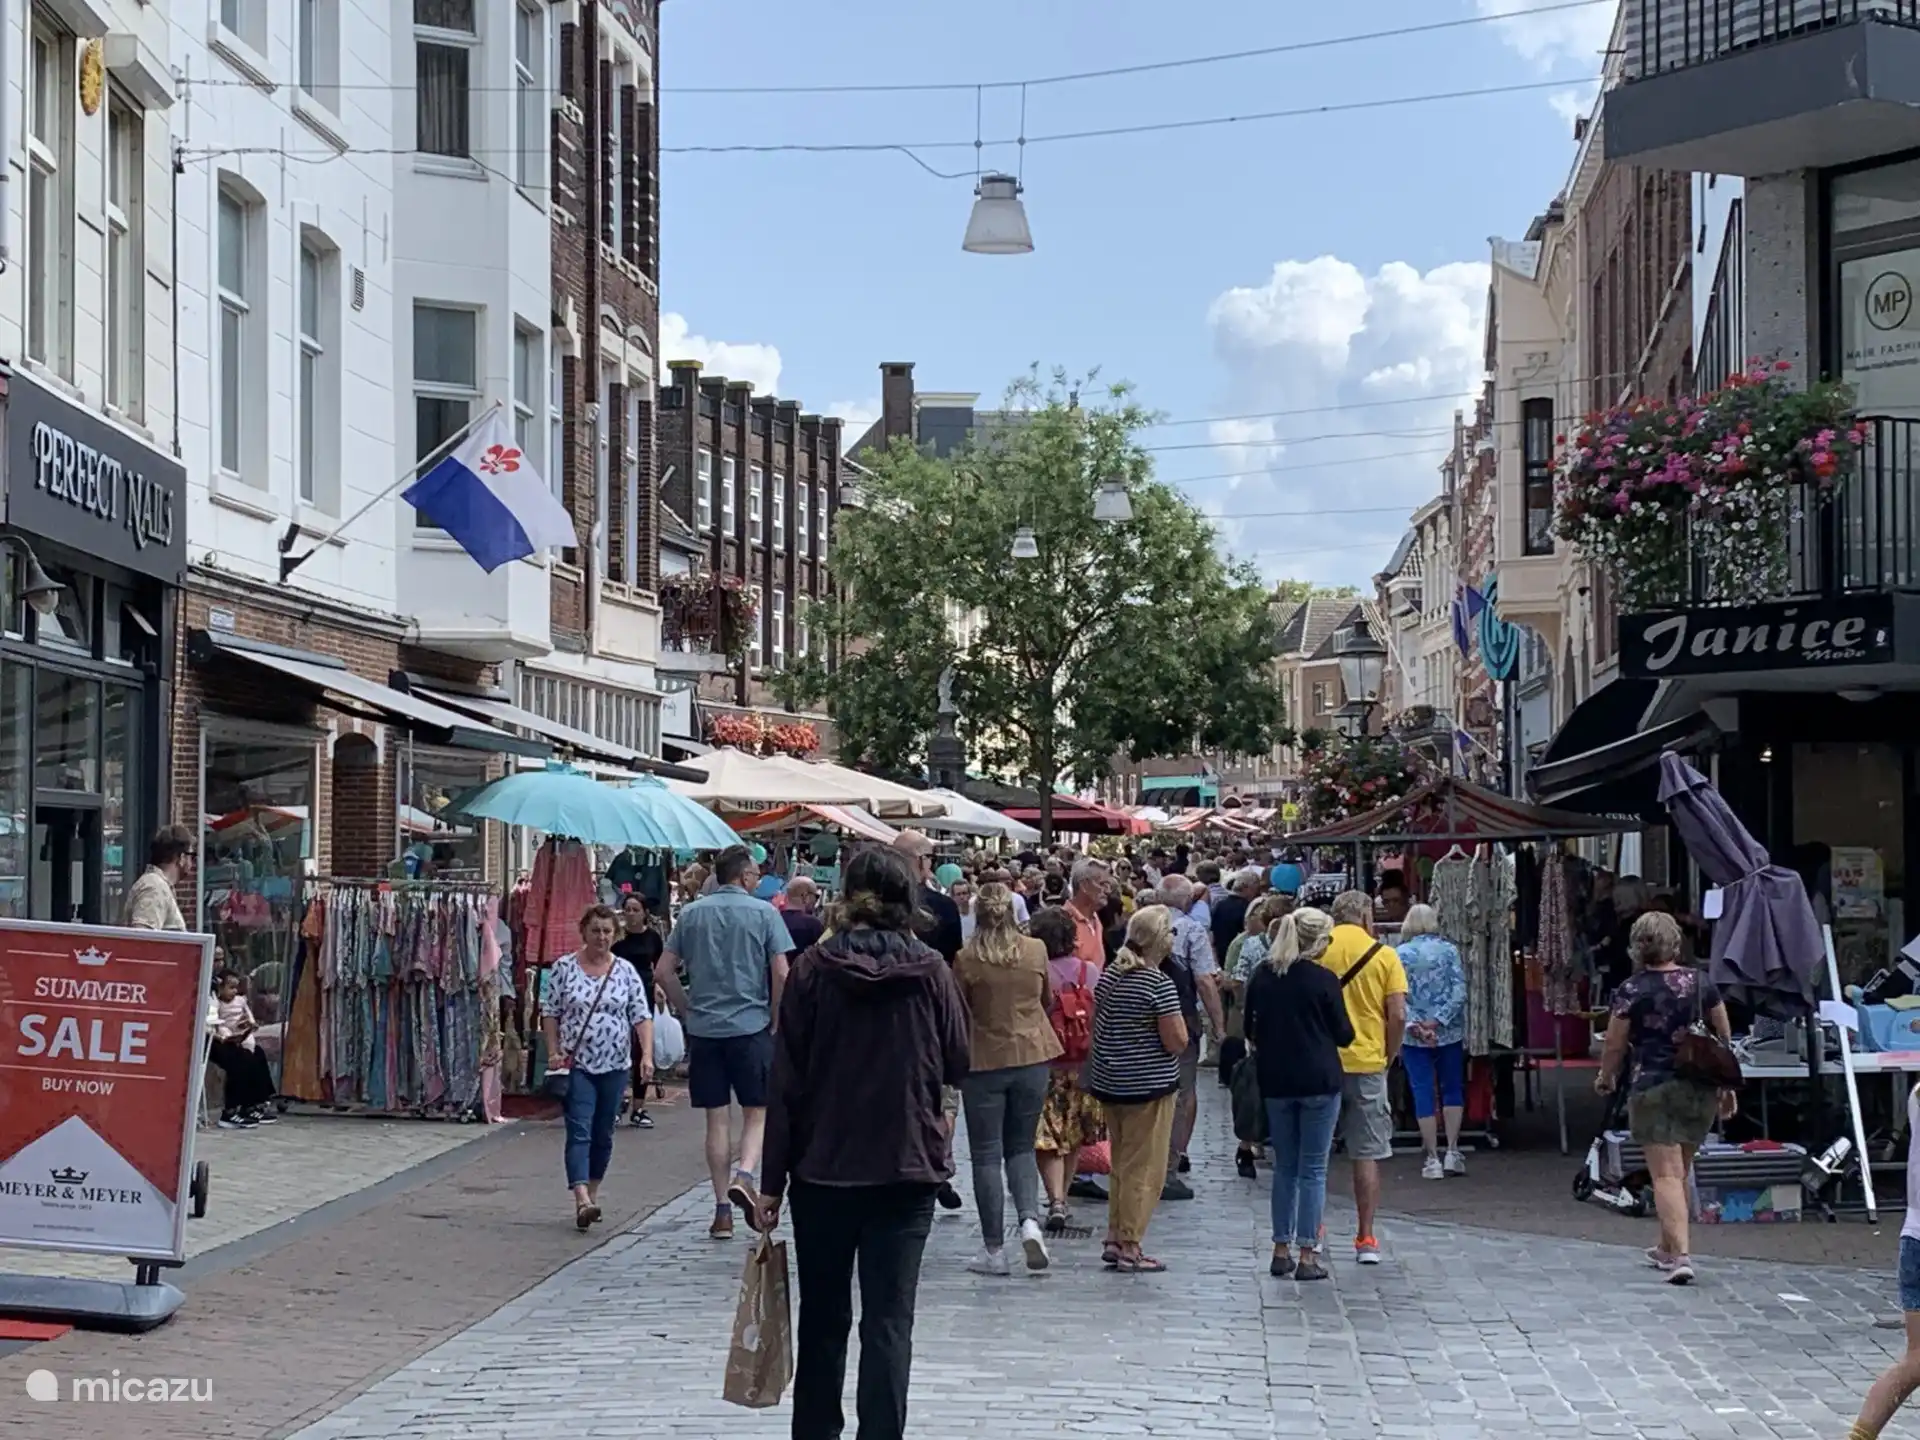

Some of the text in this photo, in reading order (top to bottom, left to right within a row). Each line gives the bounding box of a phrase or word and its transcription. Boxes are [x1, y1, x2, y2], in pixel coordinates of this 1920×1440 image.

[1873, 290, 1906, 315] MP
[1880, 341, 1920, 355] FASHI
[33, 420, 174, 549] PERFECT NAILS
[1643, 607, 1866, 671] Janice
[34, 976, 148, 1004] SUMMER
[17, 1013, 149, 1065] SALE
[41, 1076, 115, 1096] BUY NOW
[61, 1185, 75, 1200] &
[81, 1186, 142, 1204] MEYER
